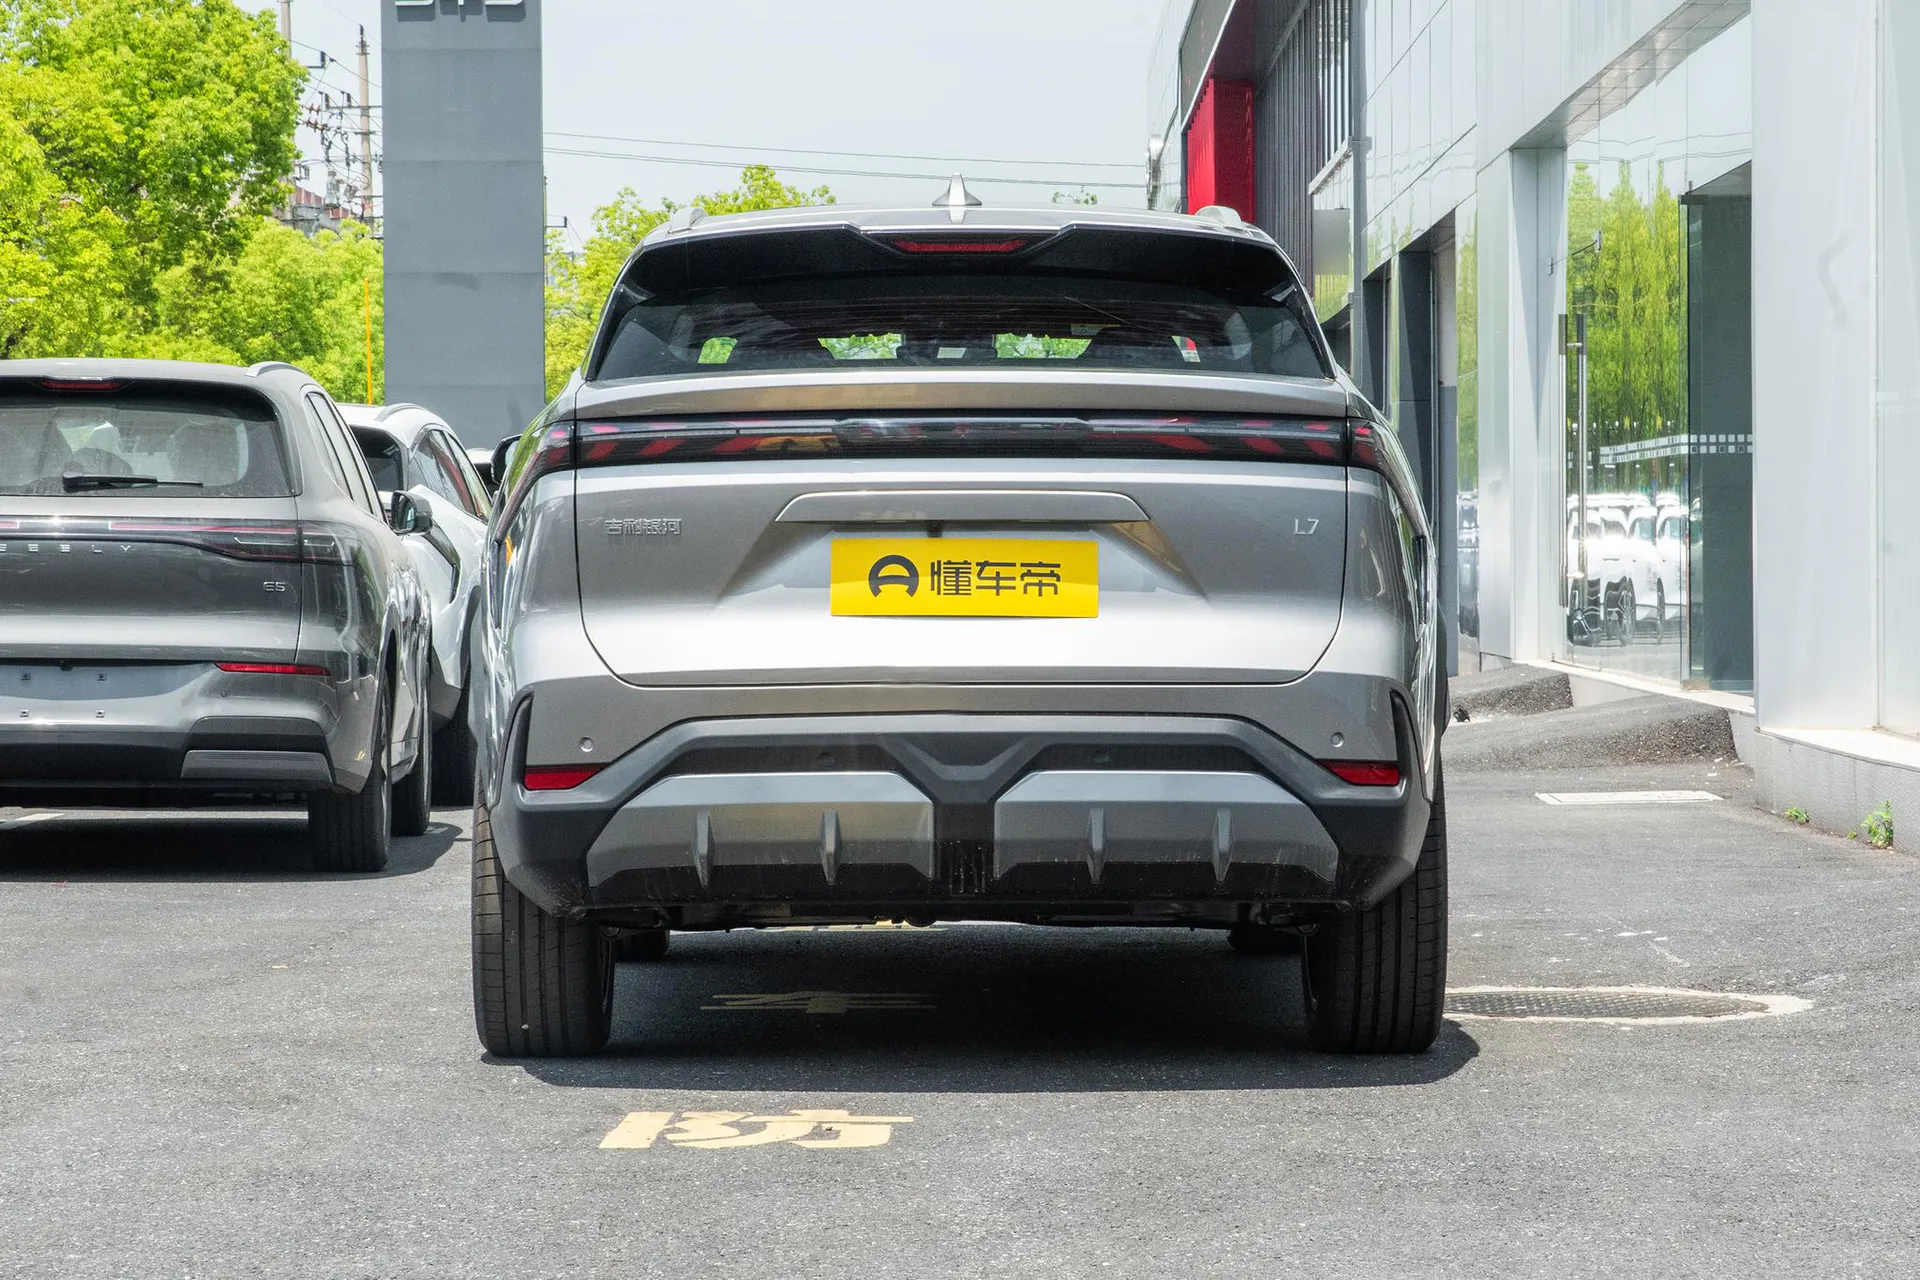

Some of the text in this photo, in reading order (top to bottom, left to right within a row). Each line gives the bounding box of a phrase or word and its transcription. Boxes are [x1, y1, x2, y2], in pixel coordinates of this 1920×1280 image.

[605, 518, 682, 536] 吉利银河
[1294, 518, 1320, 535] L7
[263, 581, 286, 592] E5
[930, 560, 1061, 597] 懂车帝
[599, 1109, 914, 1149] 防
